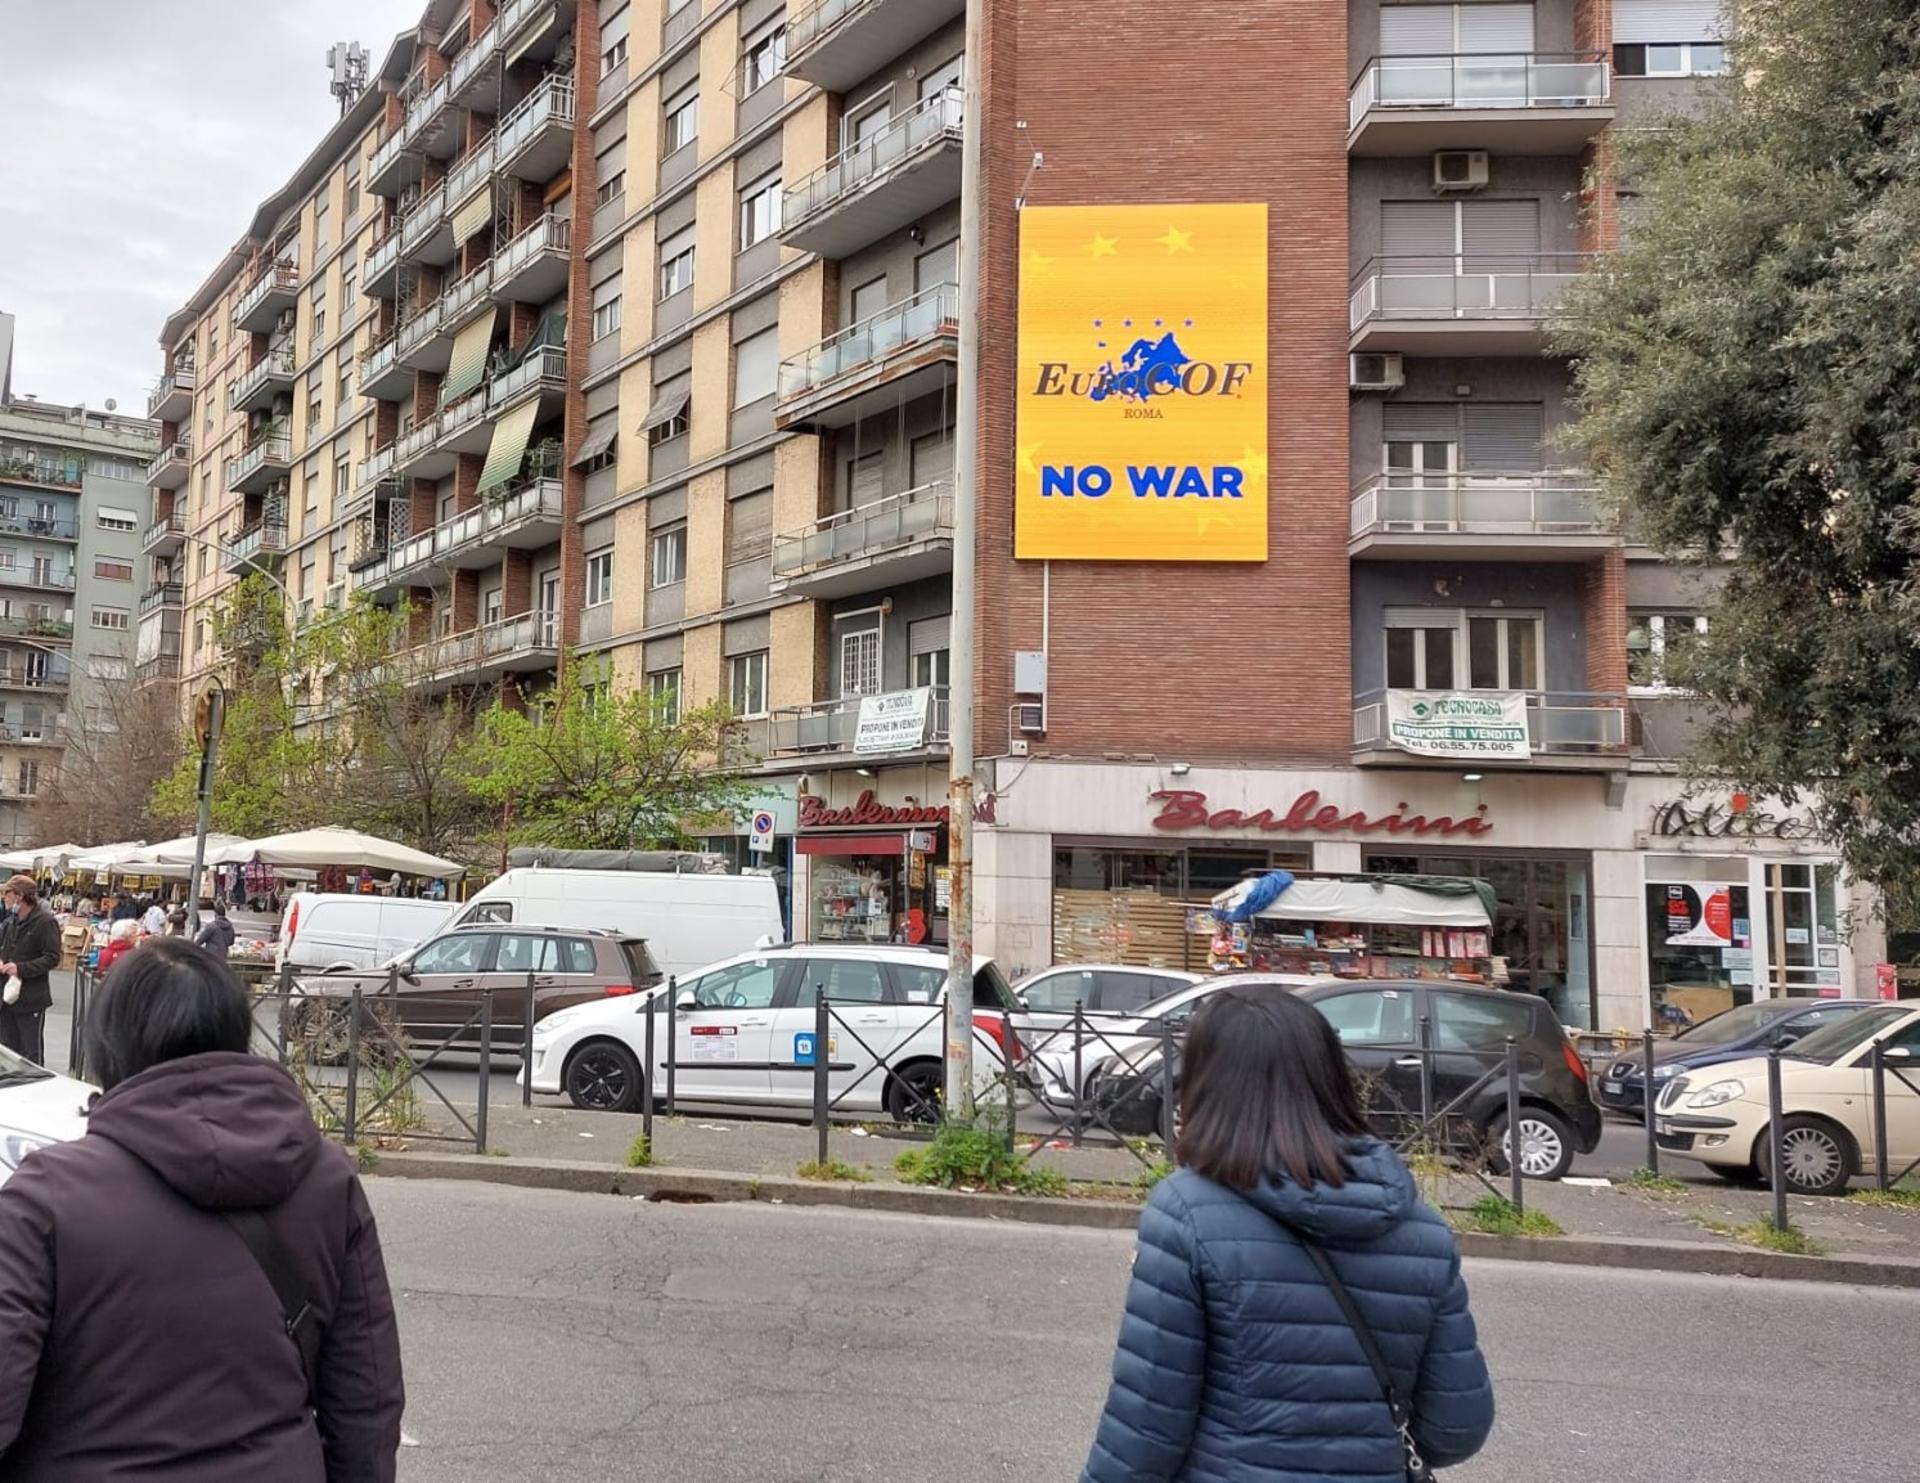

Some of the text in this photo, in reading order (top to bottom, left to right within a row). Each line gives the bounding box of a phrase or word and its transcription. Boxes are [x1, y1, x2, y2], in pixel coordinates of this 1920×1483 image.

[1124, 408, 1164, 419] ROMA
[1041, 465, 1244, 498] NO WAR
[1395, 725, 1523, 741] PROPONE IN VENDITA
[1404, 738, 1426, 749] Tel.
